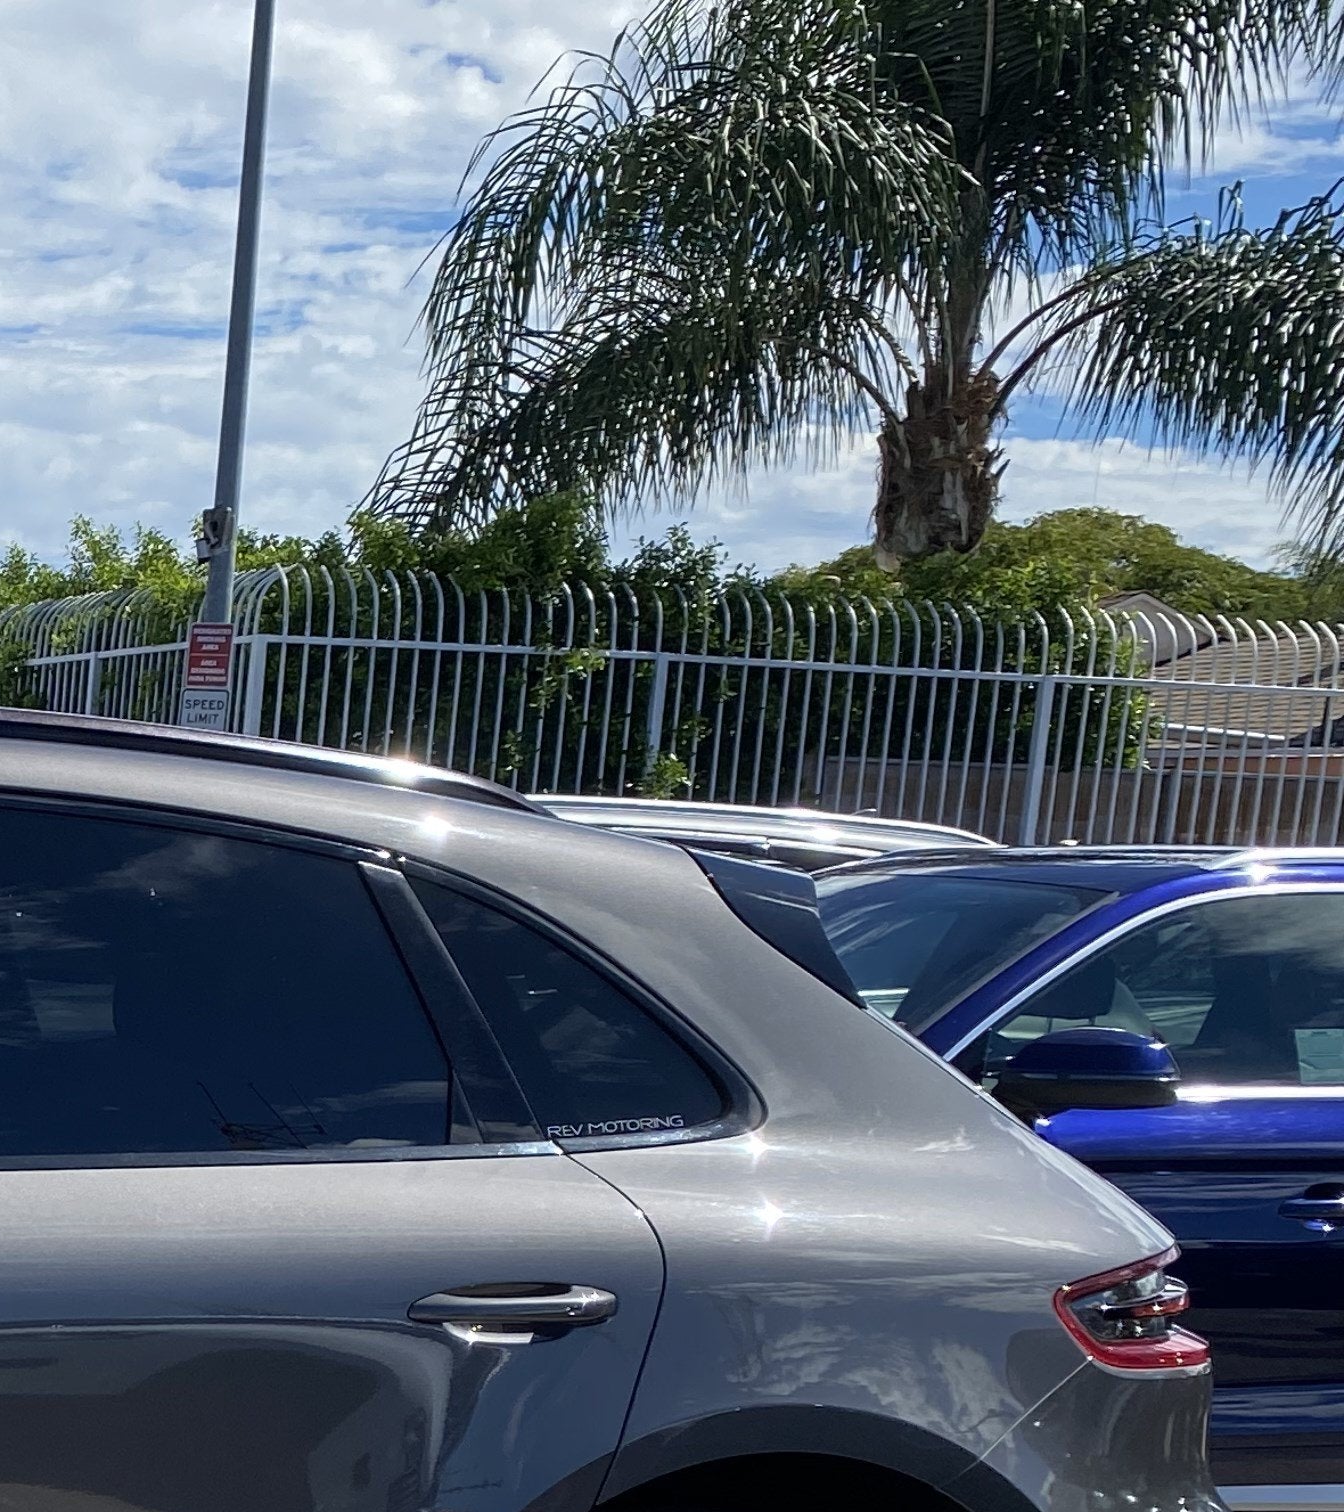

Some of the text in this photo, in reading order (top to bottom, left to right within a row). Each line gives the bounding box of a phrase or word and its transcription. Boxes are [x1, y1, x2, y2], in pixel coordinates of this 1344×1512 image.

[185, 700, 224, 710] SPEED
[187, 713, 219, 724] LIMIT
[547, 1114, 685, 1138] REV MOTORING
